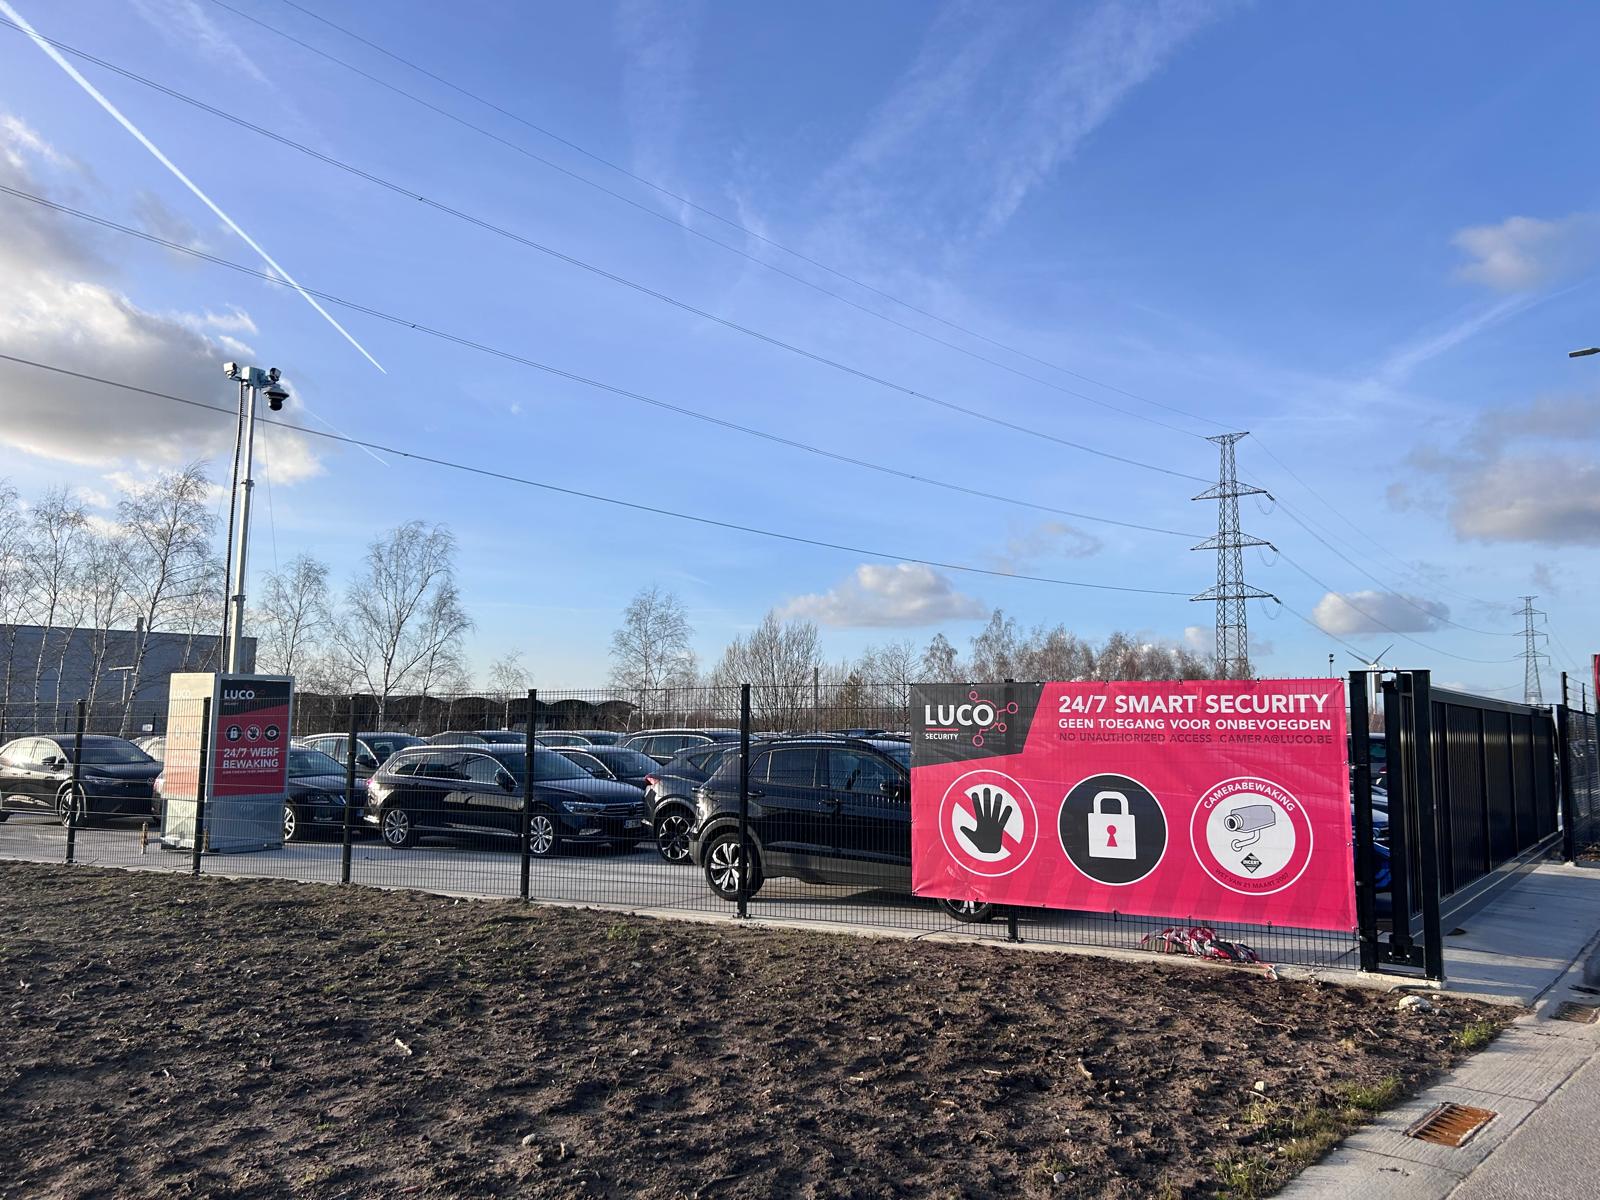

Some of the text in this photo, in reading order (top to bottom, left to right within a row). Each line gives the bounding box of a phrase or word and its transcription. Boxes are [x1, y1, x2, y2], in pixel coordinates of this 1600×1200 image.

[223, 690, 255, 700] LUCO
[1058, 694, 1329, 713] 24/7 SMART SECURITY
[925, 704, 994, 726] LUCO
[1058, 718, 1331, 731] GEEN TOEGANG VOOR ONBEVOEGDEN
[1059, 732, 1333, 744] NO UNAUTHORIZED ACCESS CAMERA@LUCO.BE
[223, 747, 280, 758] 24/7 WERF
[222, 758, 280, 769] BEWAKING
[1203, 782, 1296, 812] CAMERABEWAKING
